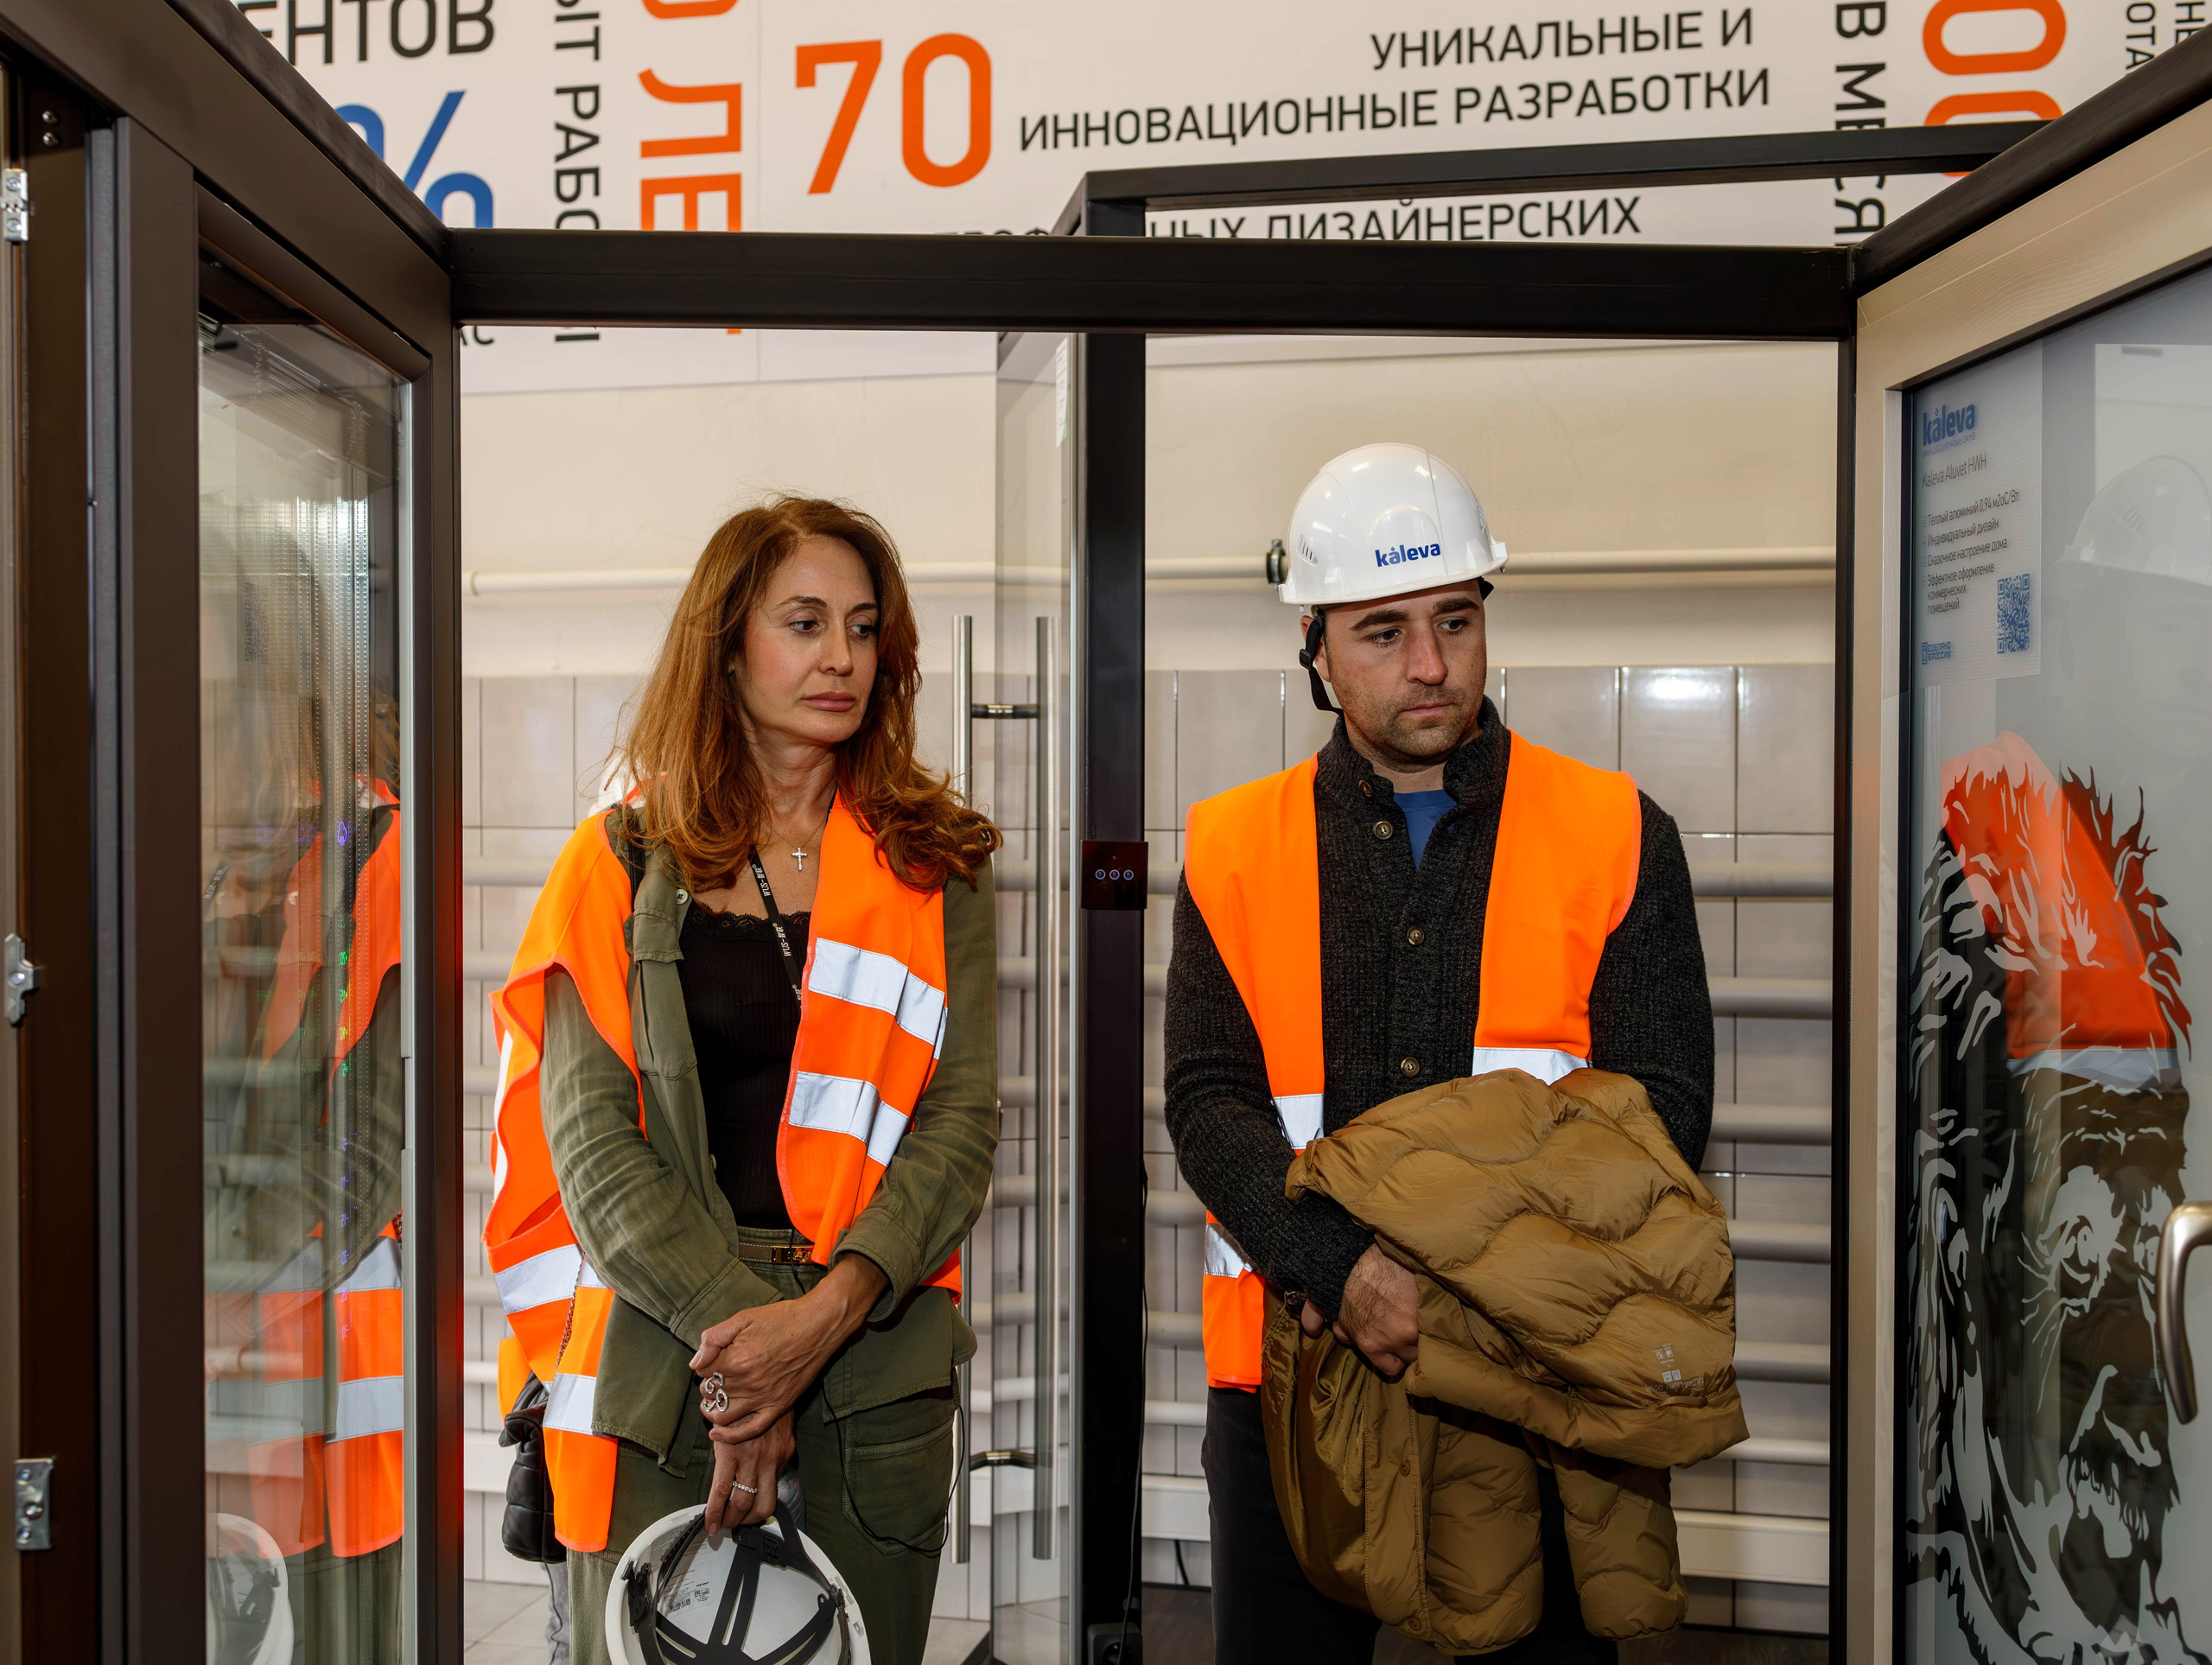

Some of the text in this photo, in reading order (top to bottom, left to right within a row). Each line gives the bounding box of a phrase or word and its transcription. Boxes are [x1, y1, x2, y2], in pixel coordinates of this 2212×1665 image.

[1836, 1, 1887, 39] В
[1370, 8, 1751, 71] УНИКАЛЬНЫЕ И
[796, 33, 992, 194] 70
[1021, 67, 1769, 151] ИННОВАЦИОННЫЕ РАЗРАБОТКИ
[1268, 197, 1641, 240] ДИЗАЙНЕРСКИХ
[1922, 469, 1944, 488] Kaleva
[1977, 518, 1999, 536] дизайн
[1957, 543, 1991, 560] настроение
[1992, 538, 2007, 553] дома
[1958, 563, 1994, 583] оформление
[1927, 597, 1960, 614] помещений
